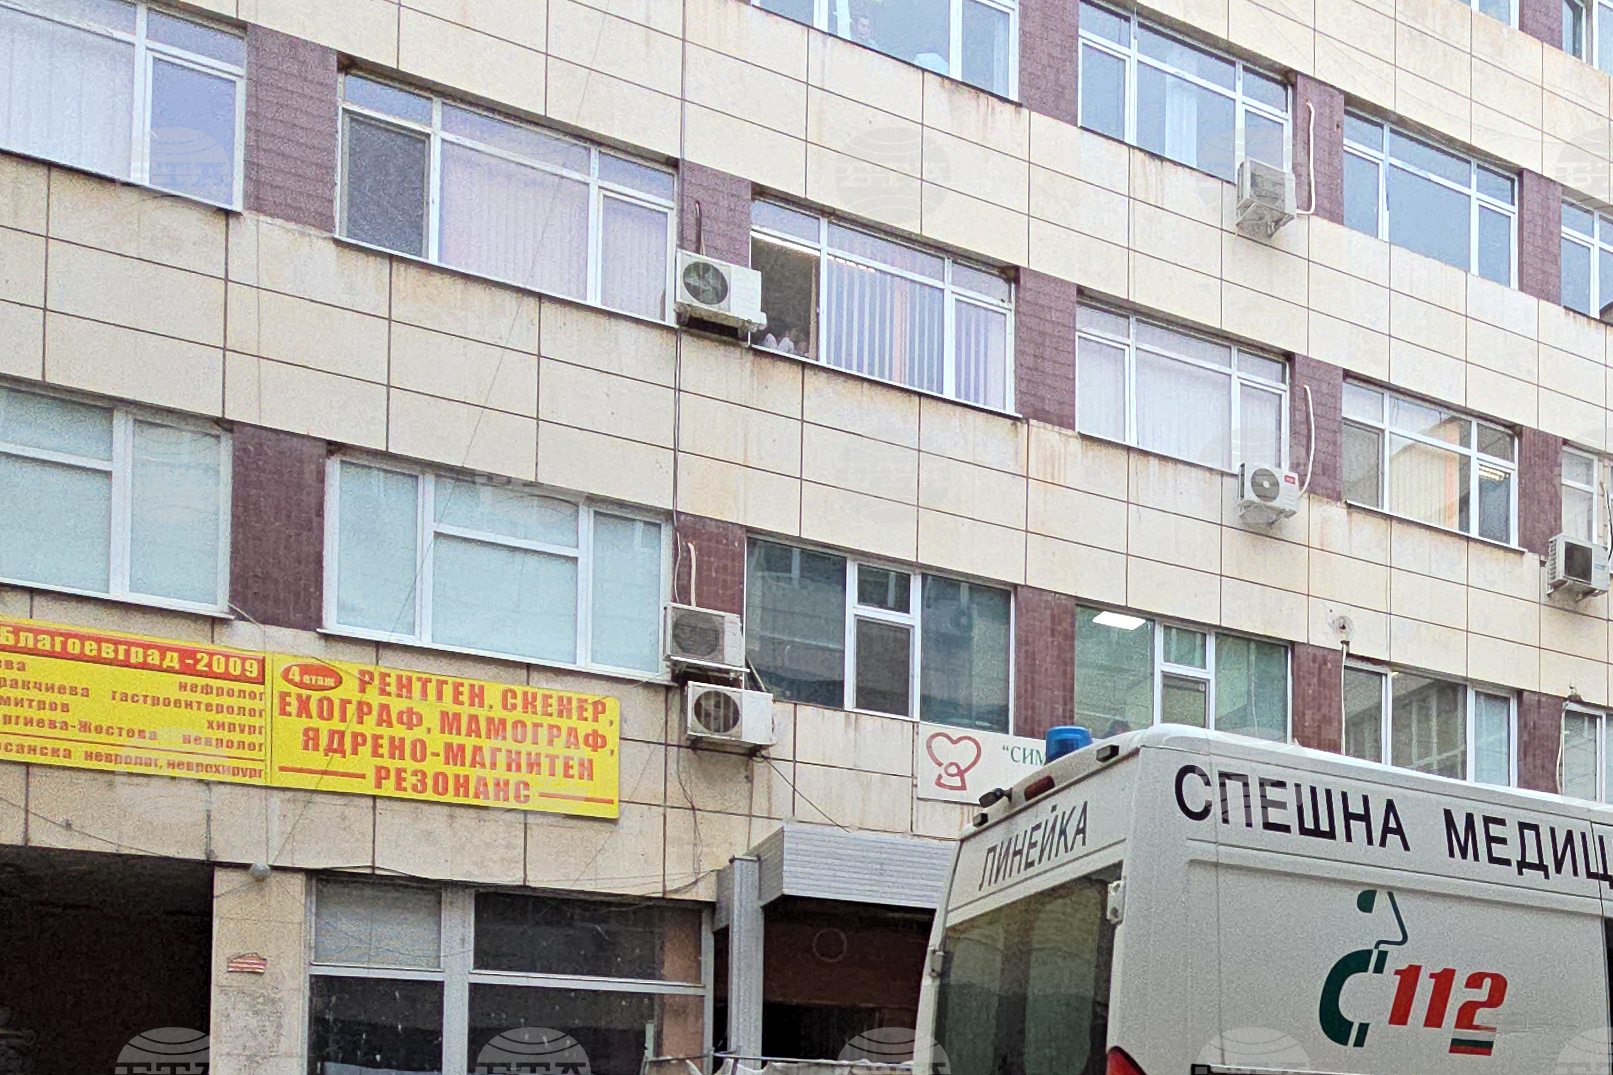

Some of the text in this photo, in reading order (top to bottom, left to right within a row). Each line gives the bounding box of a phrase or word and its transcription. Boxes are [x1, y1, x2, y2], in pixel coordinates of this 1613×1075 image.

[278, 691, 615, 757] ЕХОГРАФ, МАМОГРАФ,
[357, 668, 614, 727] РЕНТГЕН, СКЕНЕР,
[0, 742, 72, 760] санска
[302, 726, 595, 782] ЯДРЕНО-МАГНИТЕН
[374, 764, 532, 805] РЕЗОНАНС
[1174, 763, 1411, 854] СПЕШНА
[978, 801, 1089, 892] ЛИНЕЙКА
[1387, 963, 1509, 1031] 112
